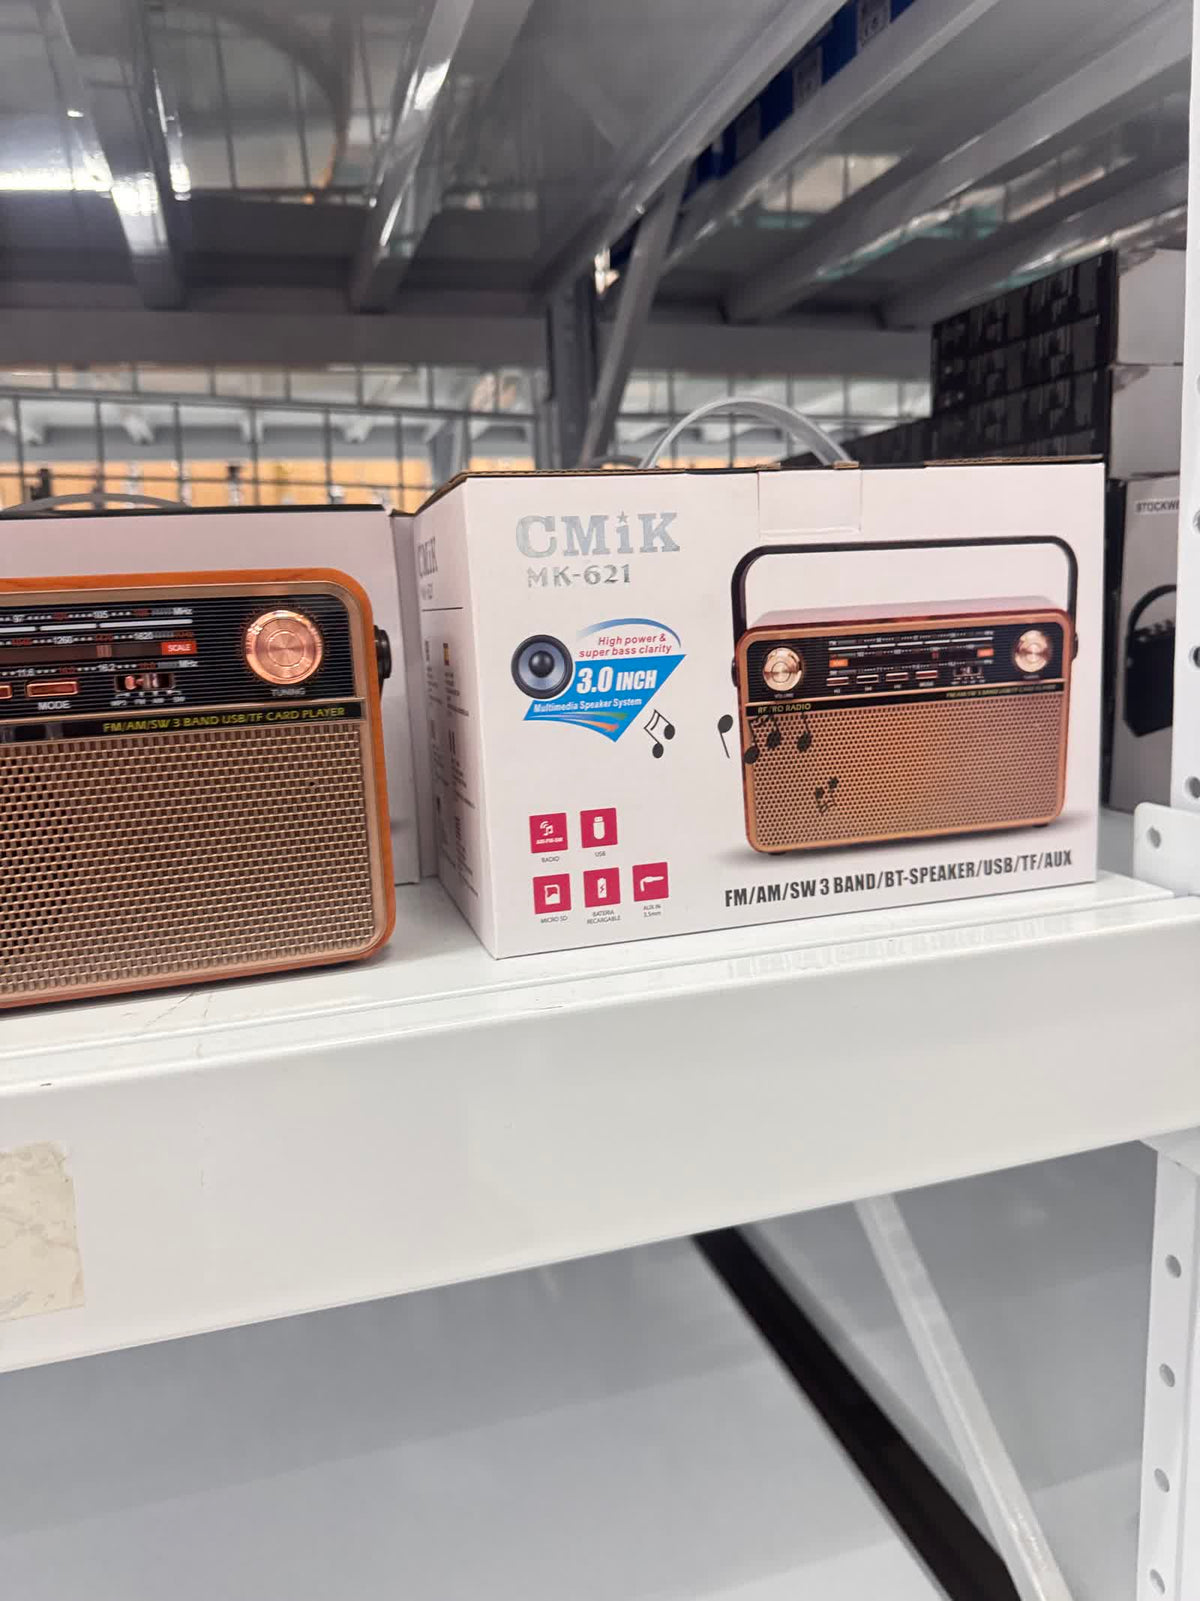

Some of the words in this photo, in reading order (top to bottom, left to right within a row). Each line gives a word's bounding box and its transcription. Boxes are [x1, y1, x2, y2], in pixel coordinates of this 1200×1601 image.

[527, 564, 631, 588] MK-621
[598, 636, 622, 647] High
[625, 634, 657, 646] power
[659, 633, 667, 642] &
[167, 643, 193, 653] SCALE
[579, 649, 609, 658] super
[611, 646, 637, 656] bass
[638, 645, 672, 655] clarity
[576, 666, 614, 694] 3.0
[615, 669, 658, 691] INCH
[38, 701, 71, 711] MODE
[533, 703, 578, 713] Multimedia
[580, 700, 612, 711] Speaker
[612, 698, 643, 708] System
[785, 703, 812, 712] RADIO
[103, 718, 170, 733] FM/AM/SW
[173, 717, 180, 728] 3
[183, 715, 219, 727] BAND
[222, 712, 263, 725] USB/TF
[266, 710, 299, 722] CARD
[302, 707, 345, 719] PLAYER
[725, 880, 817, 907] FM/AM/SW
[820, 878, 830, 896] 3
